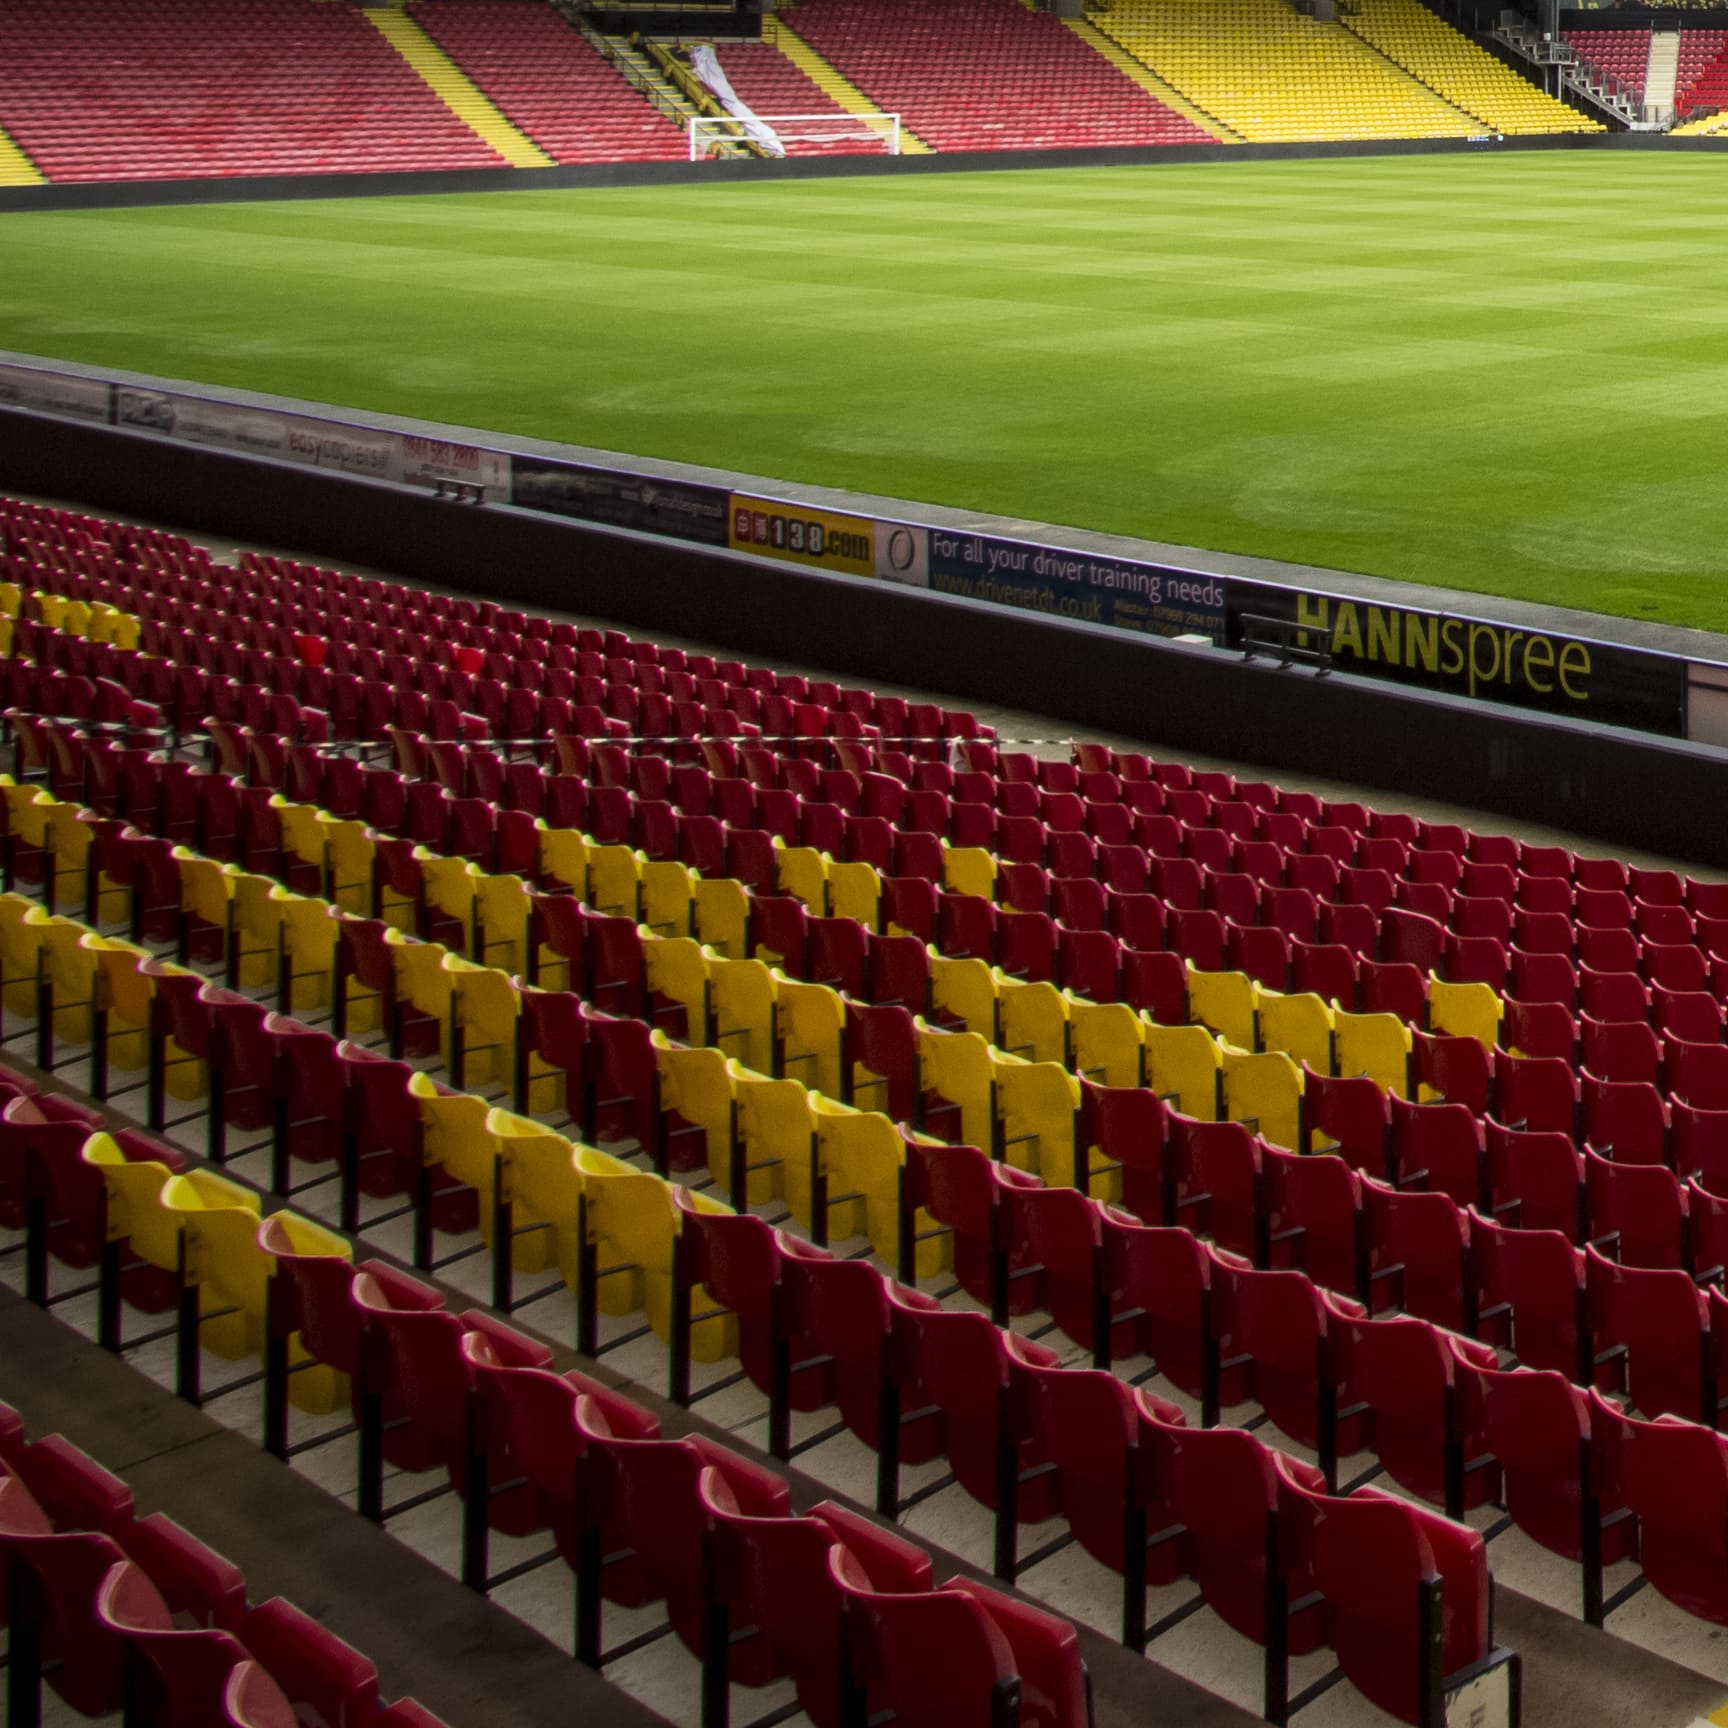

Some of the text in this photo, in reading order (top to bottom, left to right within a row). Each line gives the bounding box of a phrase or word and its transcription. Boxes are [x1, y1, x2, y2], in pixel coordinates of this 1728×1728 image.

[933, 533, 1224, 607] For all your driver training needs
